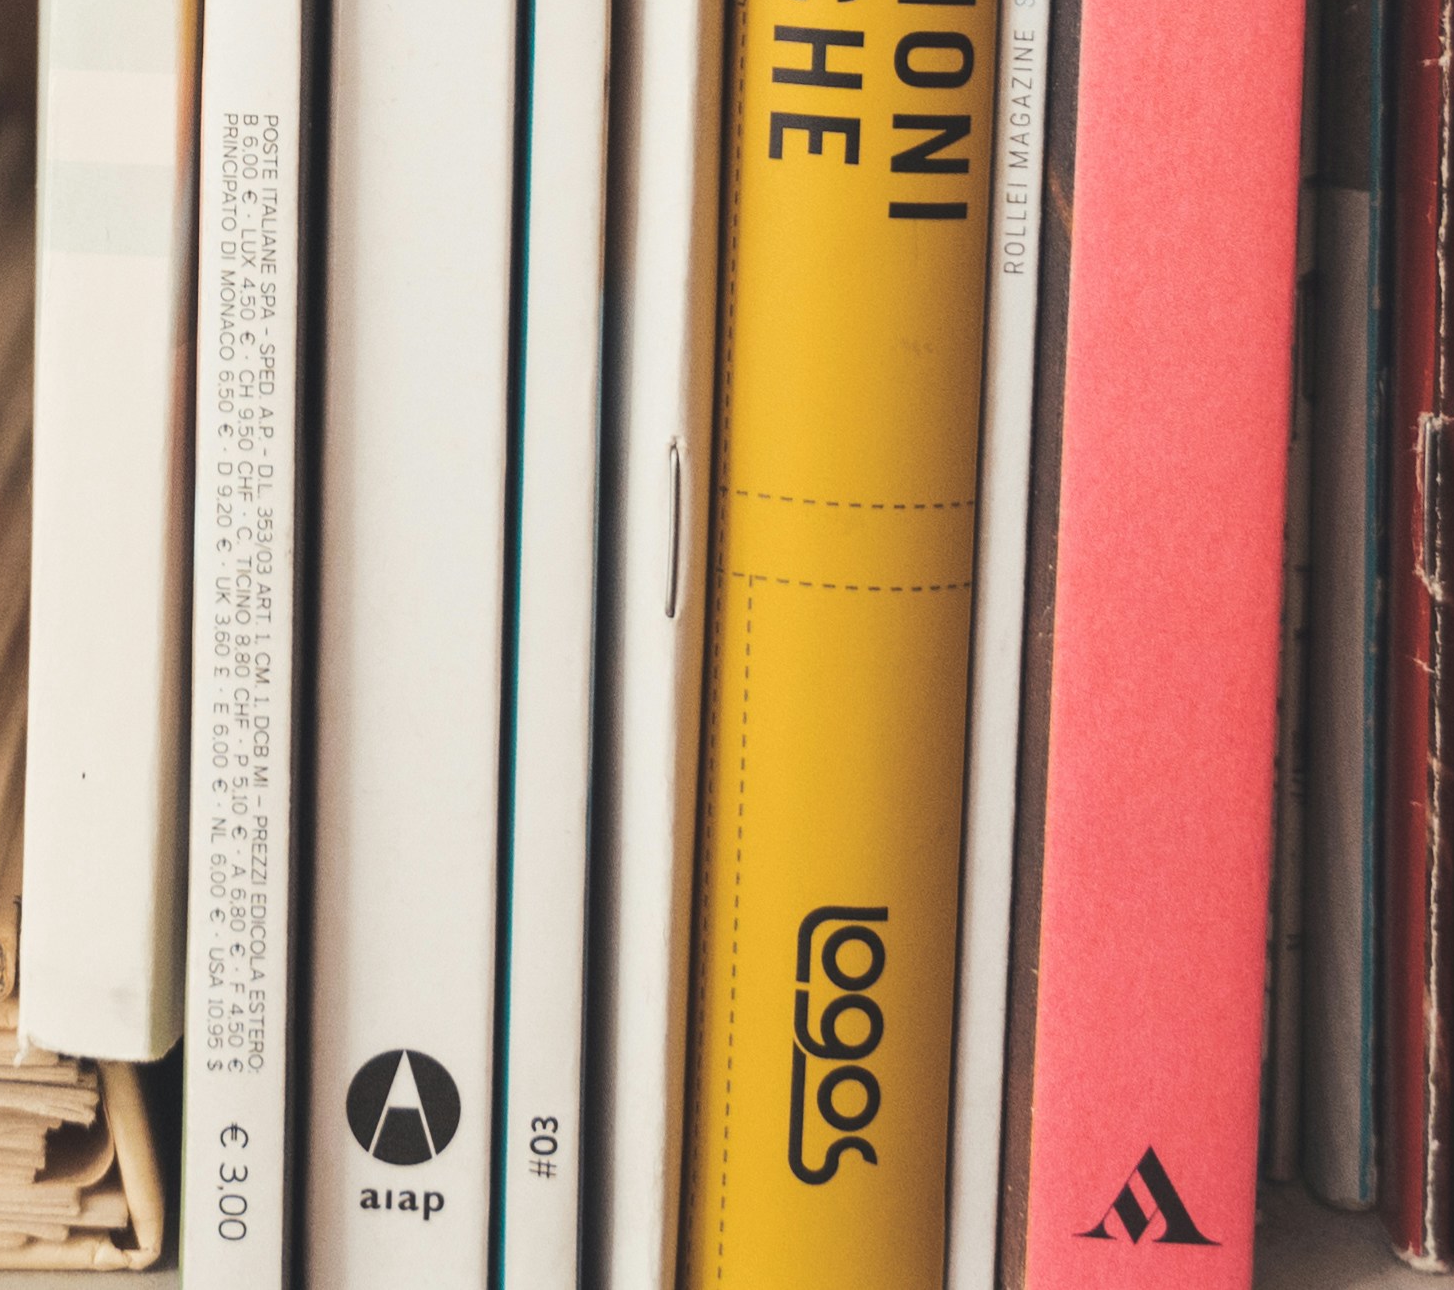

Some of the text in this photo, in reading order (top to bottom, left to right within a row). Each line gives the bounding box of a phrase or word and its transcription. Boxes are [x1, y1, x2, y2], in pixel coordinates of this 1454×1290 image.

[1006, 29, 1035, 169] MAGAZINE
[1001, 181, 1028, 275] ROLLEI
[216, 1122, 249, 1241] € 3,00
[529, 1116, 559, 1179] #03
[359, 1186, 446, 1221] aiap
